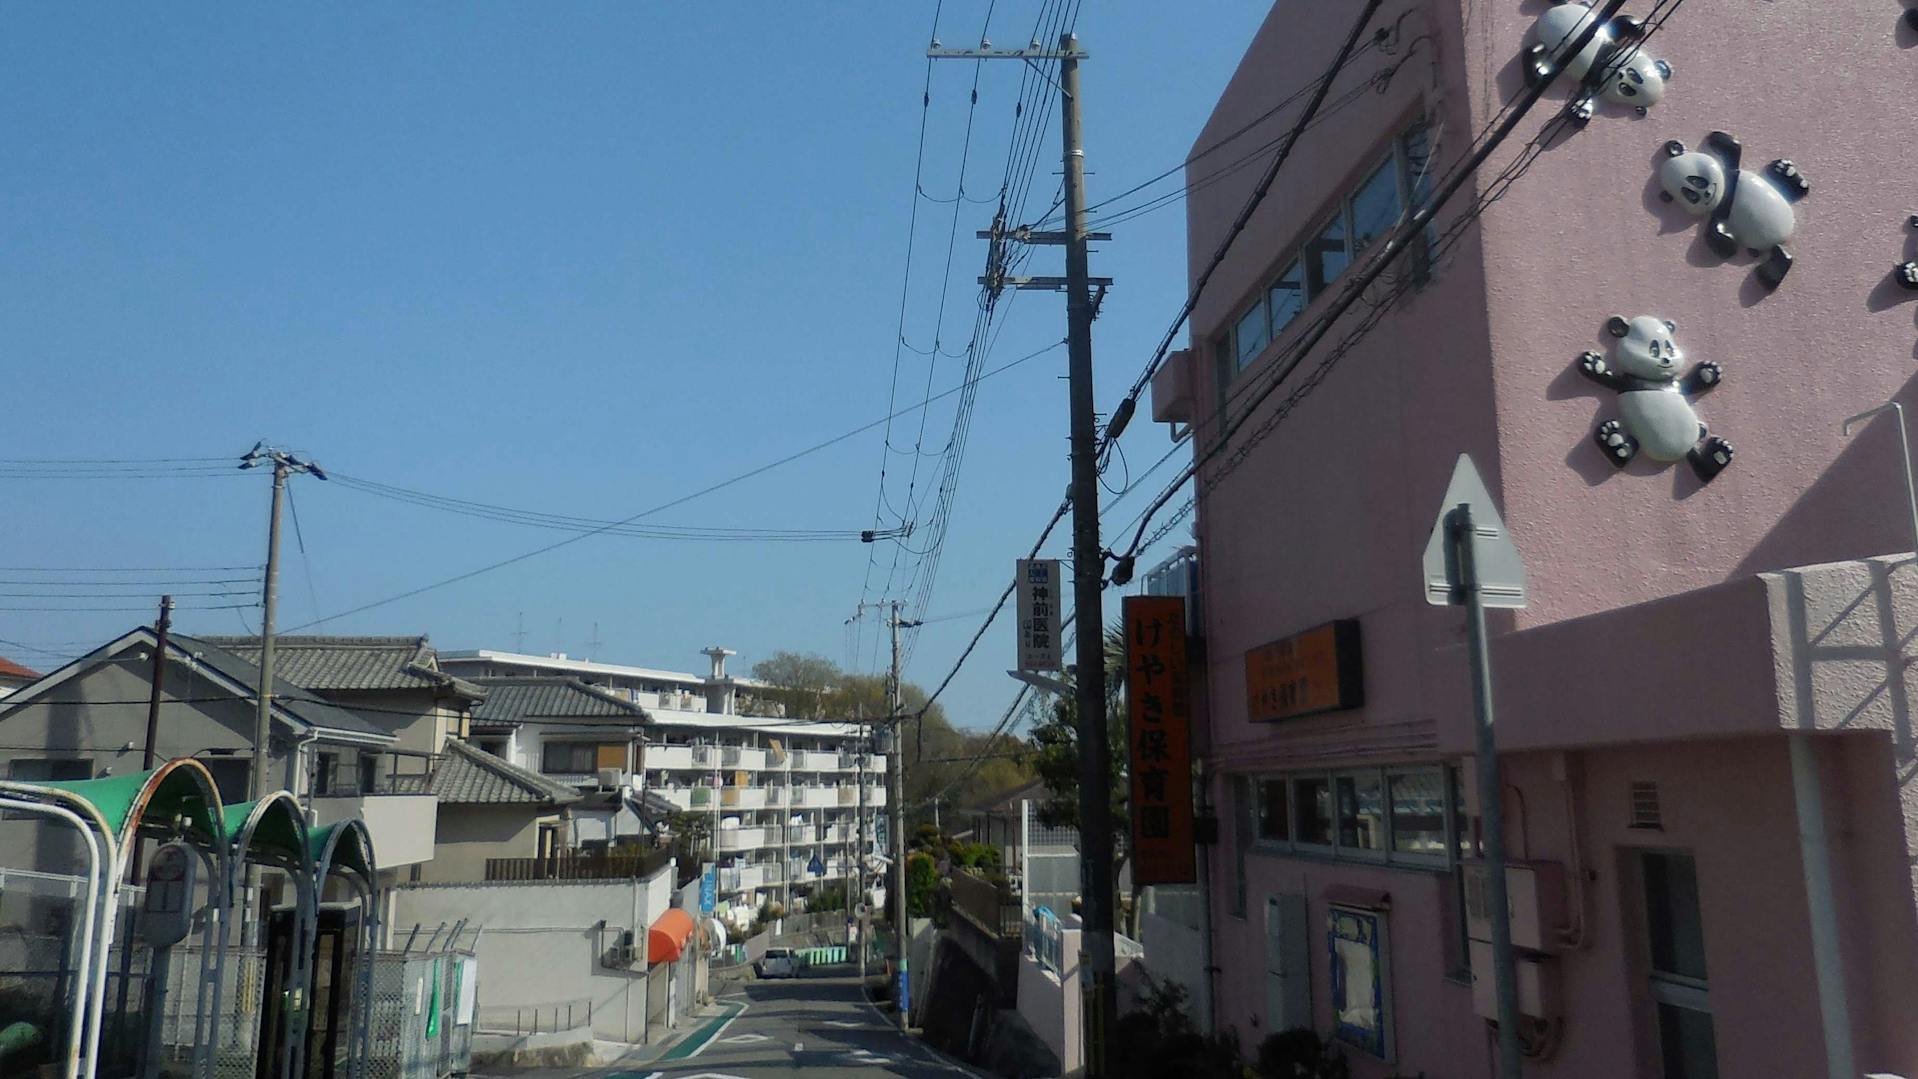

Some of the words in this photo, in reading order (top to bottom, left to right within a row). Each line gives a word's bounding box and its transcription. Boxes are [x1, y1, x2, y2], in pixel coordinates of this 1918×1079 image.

[1032, 586, 1050, 649] 神前医院
[1136, 619, 1169, 838] けやき保育園
